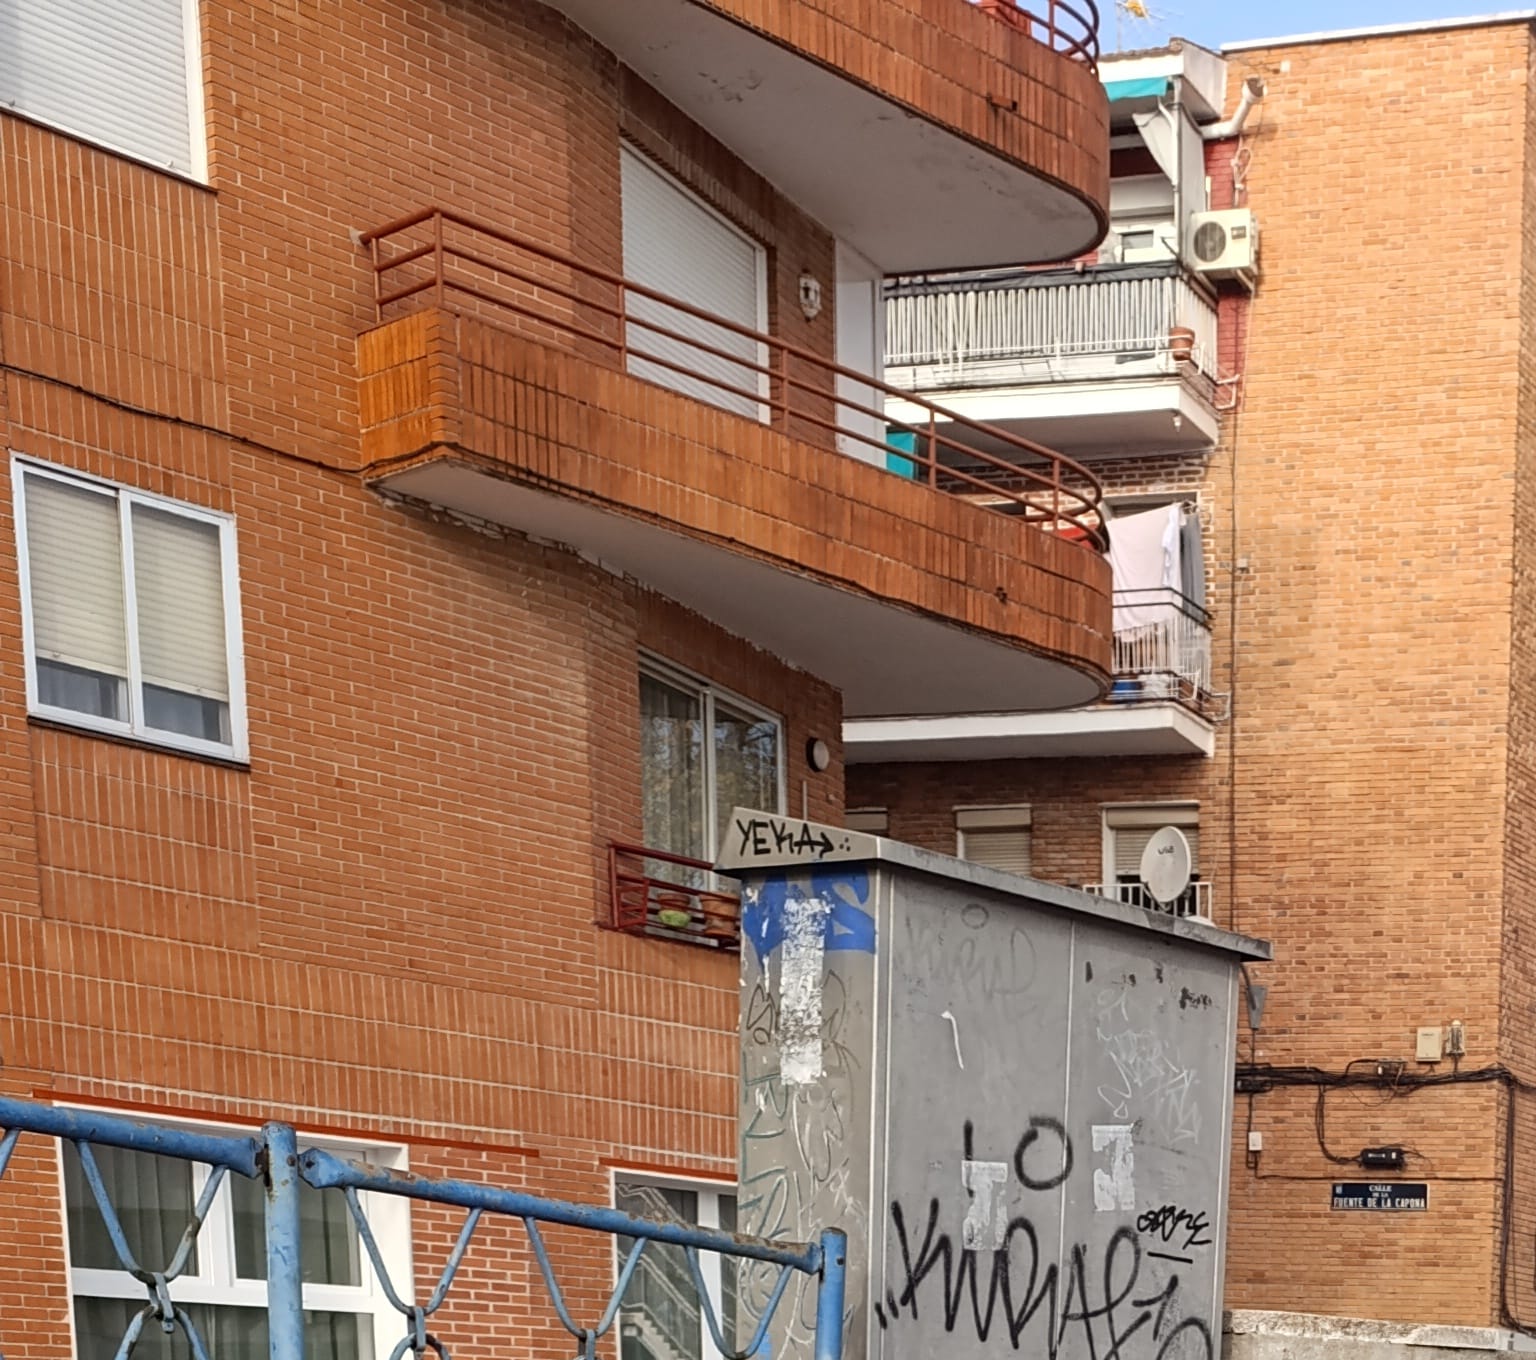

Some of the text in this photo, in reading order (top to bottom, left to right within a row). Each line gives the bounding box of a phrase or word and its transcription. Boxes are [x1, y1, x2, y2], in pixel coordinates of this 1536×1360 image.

[1368, 1184, 1392, 1192] CALLE
[1333, 1197, 1364, 1208] FUENTE
[1367, 1197, 1377, 1208] DE
[1381, 1198, 1392, 1208] LA
